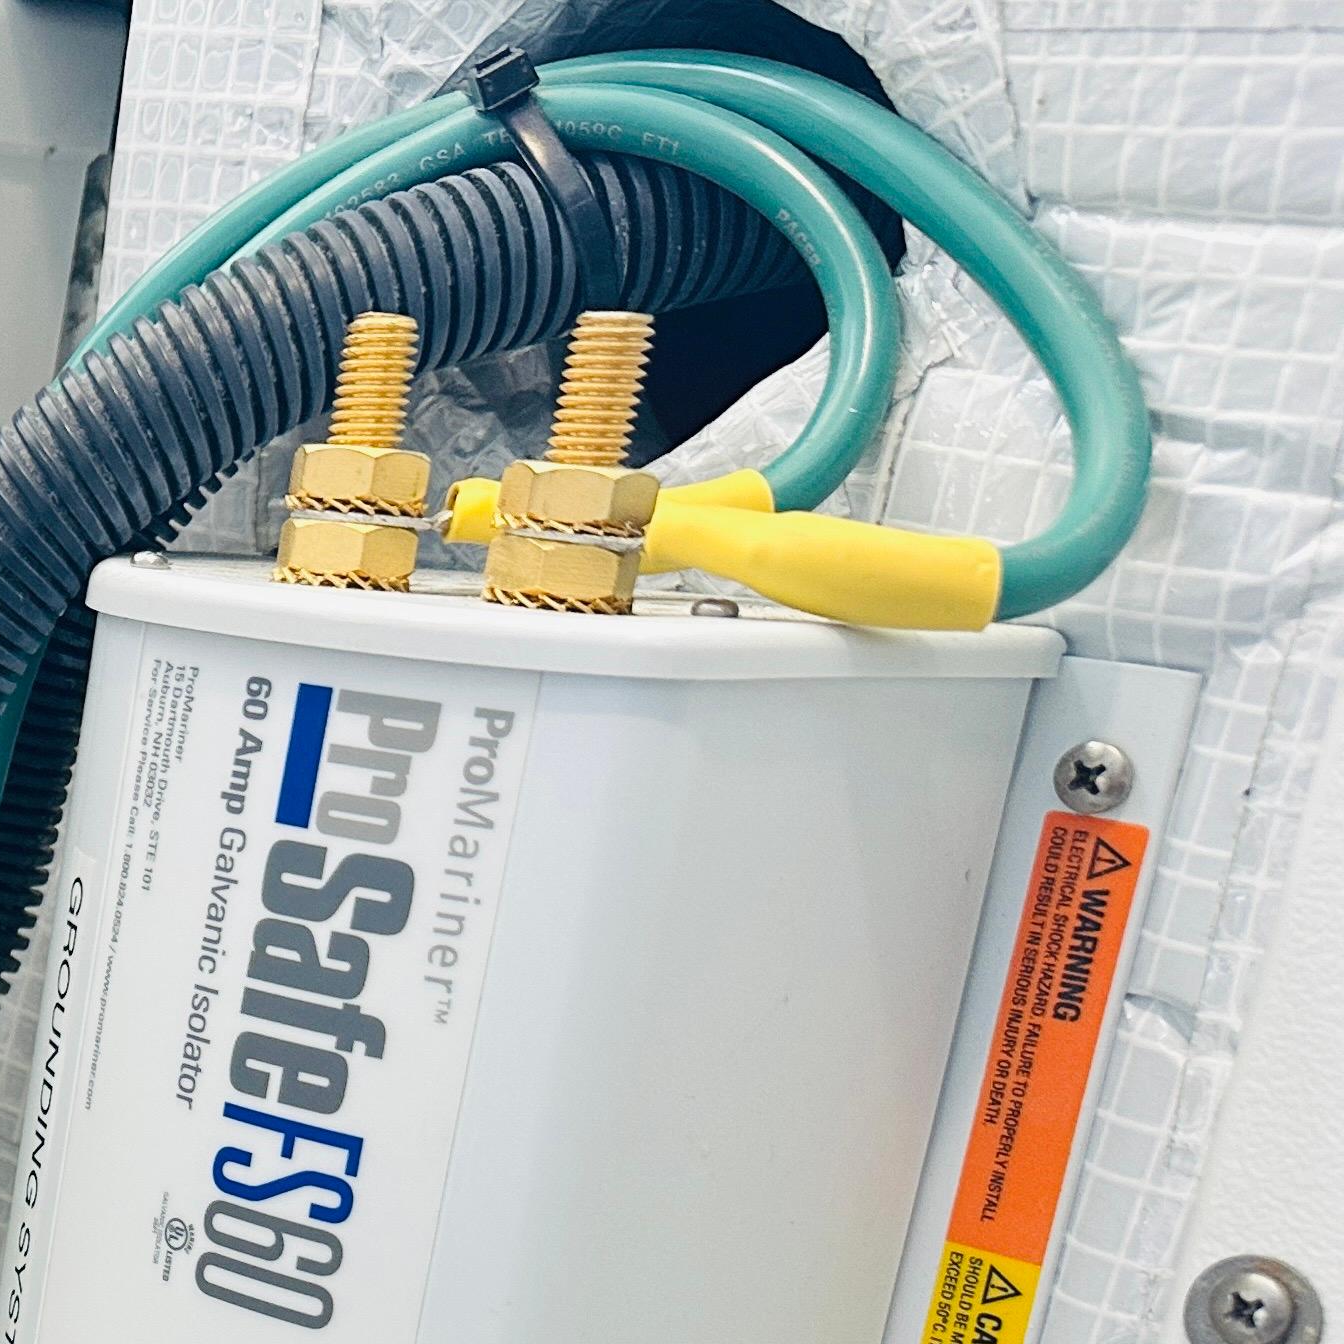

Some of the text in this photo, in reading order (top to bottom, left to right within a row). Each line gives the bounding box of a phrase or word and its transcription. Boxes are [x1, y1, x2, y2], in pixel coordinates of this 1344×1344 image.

[150, 658, 161, 684] For
[154, 660, 173, 724] Auburn,
[140, 687, 156, 746] Service
[159, 686, 182, 773] Dartmouth
[174, 665, 199, 761] ProMariner
[150, 731, 162, 758] NH
[132, 750, 146, 802] Please
[144, 828, 160, 863] STE
[1043, 826, 1067, 873] COULD
[1055, 829, 1089, 910] ELECTRICAL
[140, 867, 153, 891] 101
[175, 676, 272, 1109] 60 Amp Galvanic Isolator
[1030, 876, 1055, 928] RESULT
[1043, 913, 1069, 959] SHOCK
[1052, 889, 1109, 1021] WARNING
[1011, 948, 1038, 1005] SERIOUS
[1030, 961, 1056, 1017] HAZARD.
[24, 876, 84, 1209] GROUNDING
[1000, 1008, 1023, 1057] INJURY
[1015, 1022, 1042, 1076] FAILURE
[983, 1080, 1006, 1124] DEATH.
[994, 1100, 1022, 1168] PROPERLY
[979, 1169, 1005, 1221] INSTALL
[161, 1250, 172, 1281] LISTED
[940, 1251, 963, 1300] EXCEED
[958, 1256, 983, 1310] SHOULD
